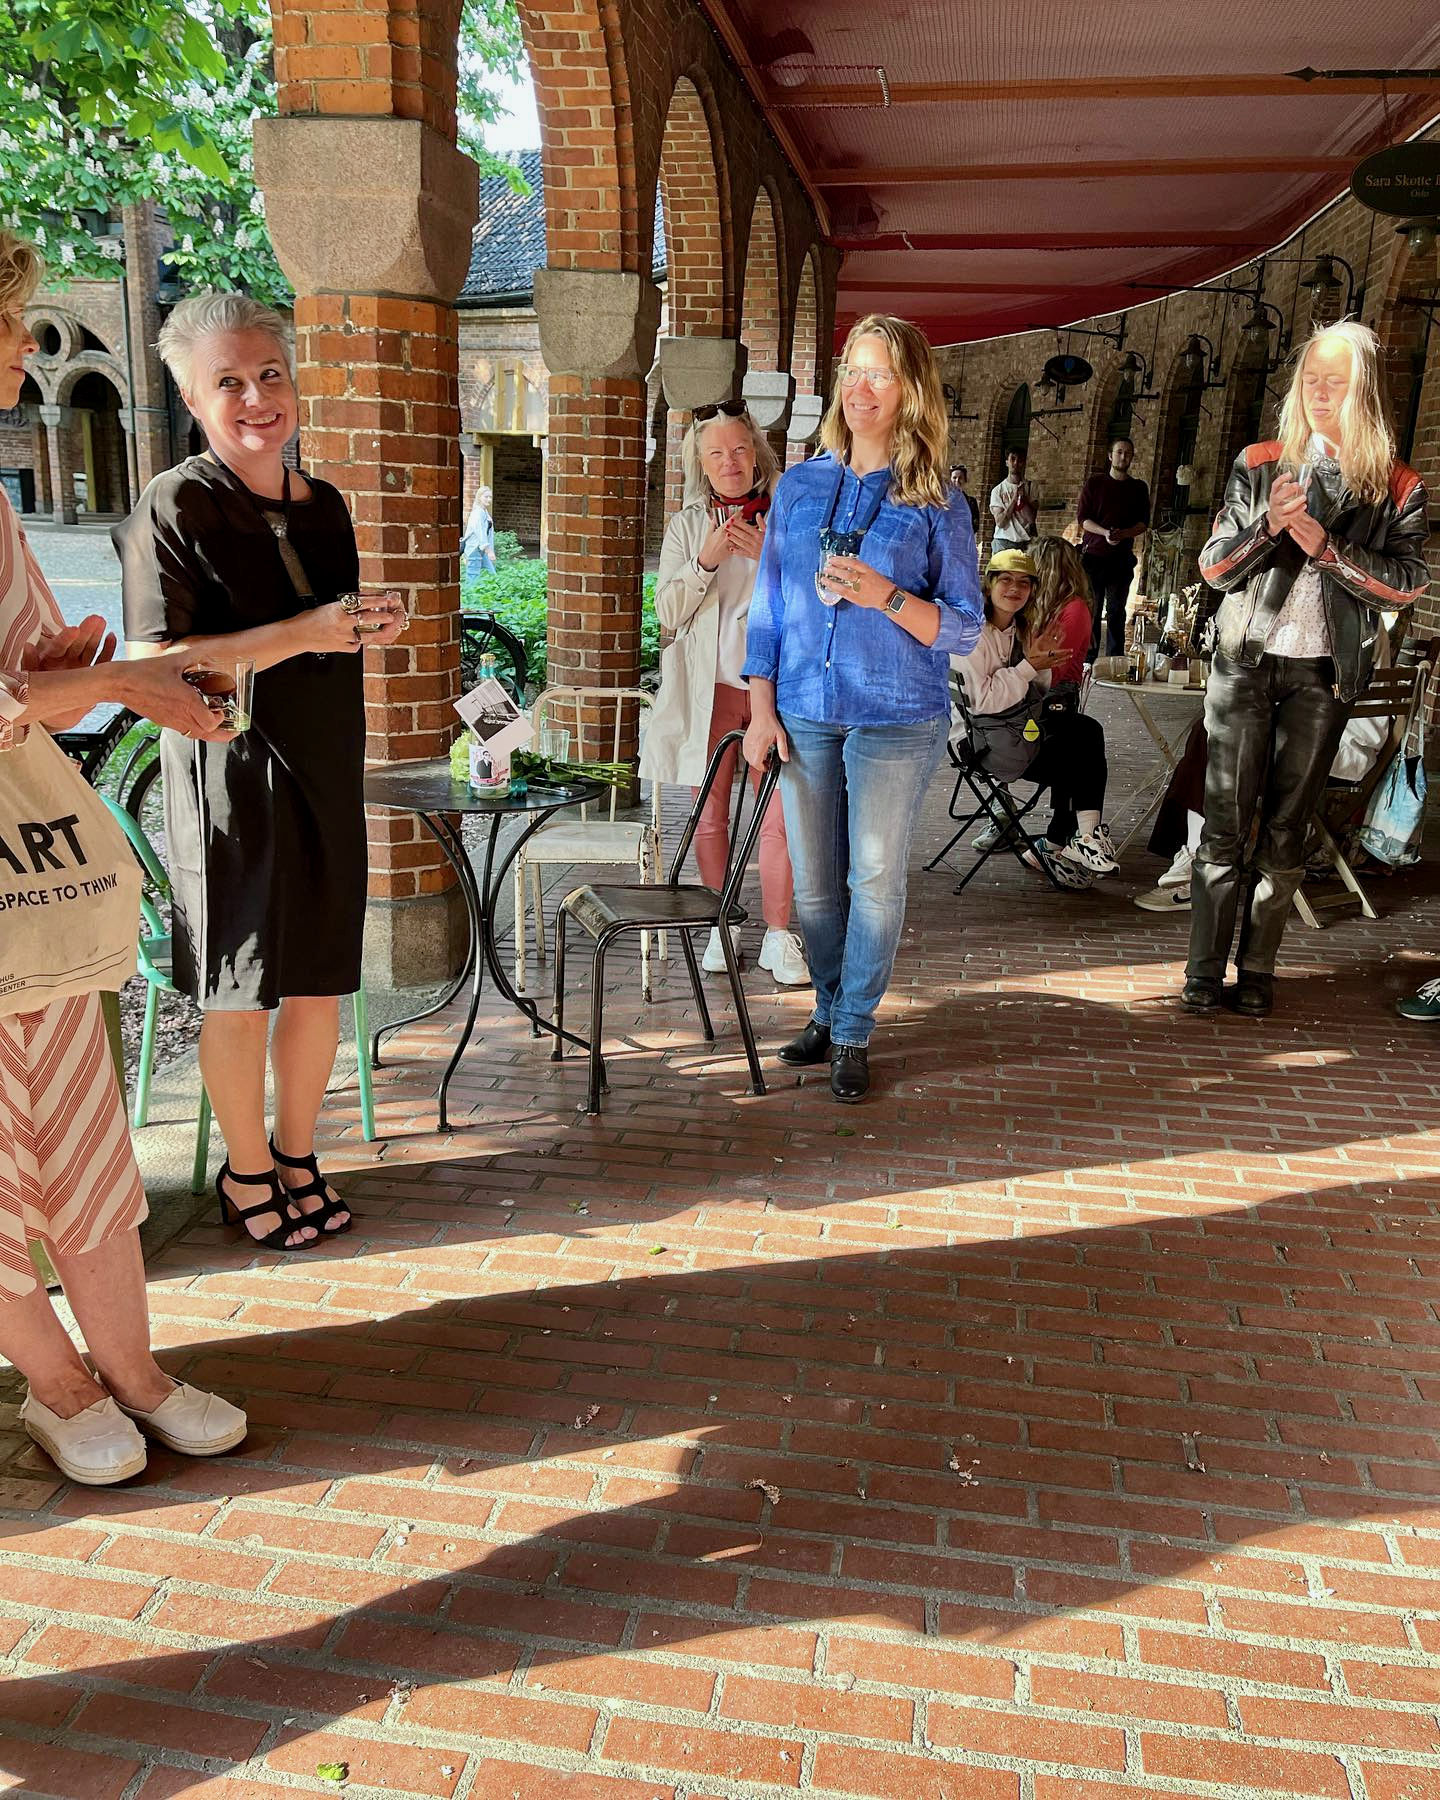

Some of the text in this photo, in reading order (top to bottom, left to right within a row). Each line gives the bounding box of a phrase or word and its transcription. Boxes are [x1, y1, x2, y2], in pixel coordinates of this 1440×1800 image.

[1365, 174, 1391, 187] Sara
[0, 873, 118, 911] SPACE TO THINK
